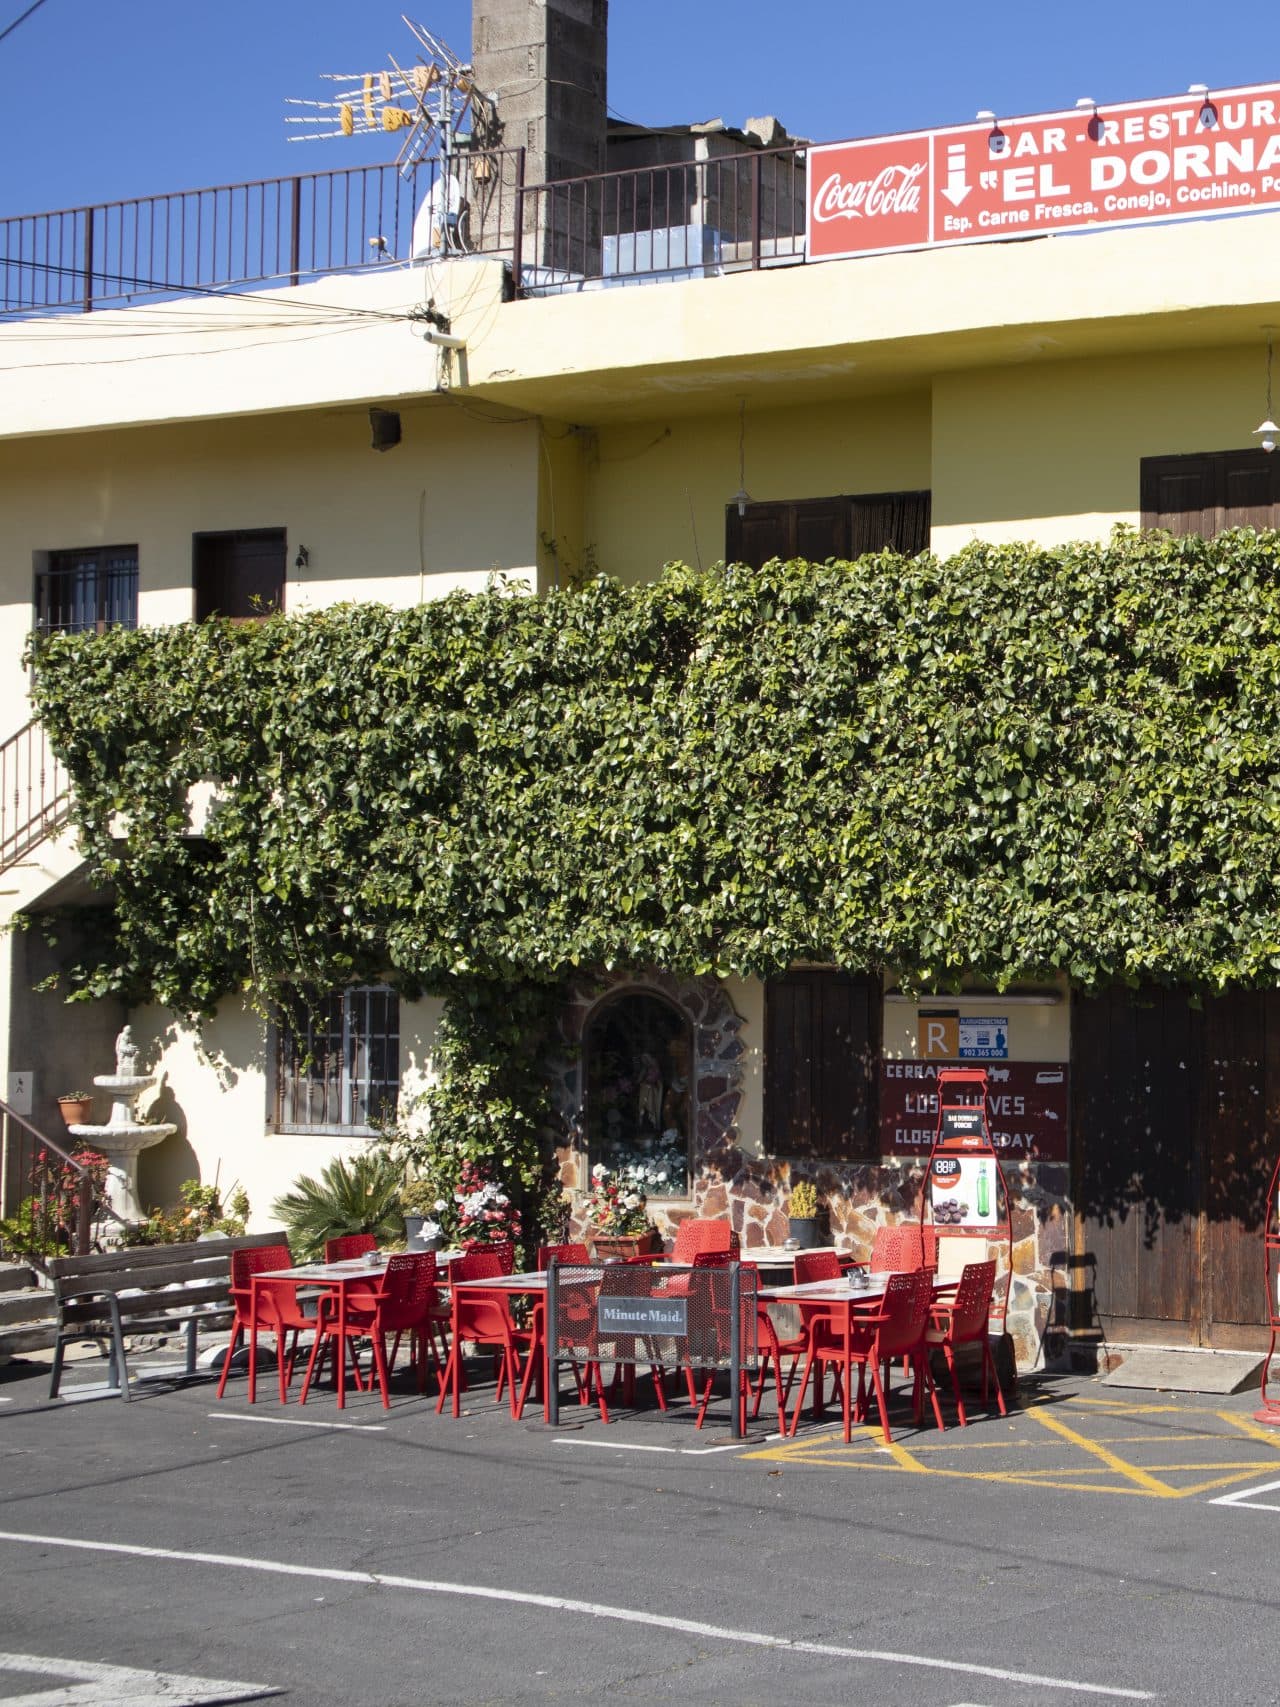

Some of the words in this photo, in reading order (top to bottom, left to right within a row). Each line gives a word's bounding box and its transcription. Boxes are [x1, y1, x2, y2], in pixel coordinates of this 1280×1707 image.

[988, 127, 1067, 161] BAR
[813, 161, 929, 223] Coca-Cola
[944, 214, 972, 232] Esp.
[978, 209, 1029, 227] Carne
[1104, 190, 1171, 211] Conejo,
[1176, 180, 1255, 203] Cochino,
[928, 1023, 949, 1053] R
[963, 1049, 976, 1057] 902
[977, 1049, 989, 1057] 365
[990, 1049, 1004, 1057] 000
[905, 1093, 939, 1114] LOS
[603, 1308, 648, 1321] Minute
